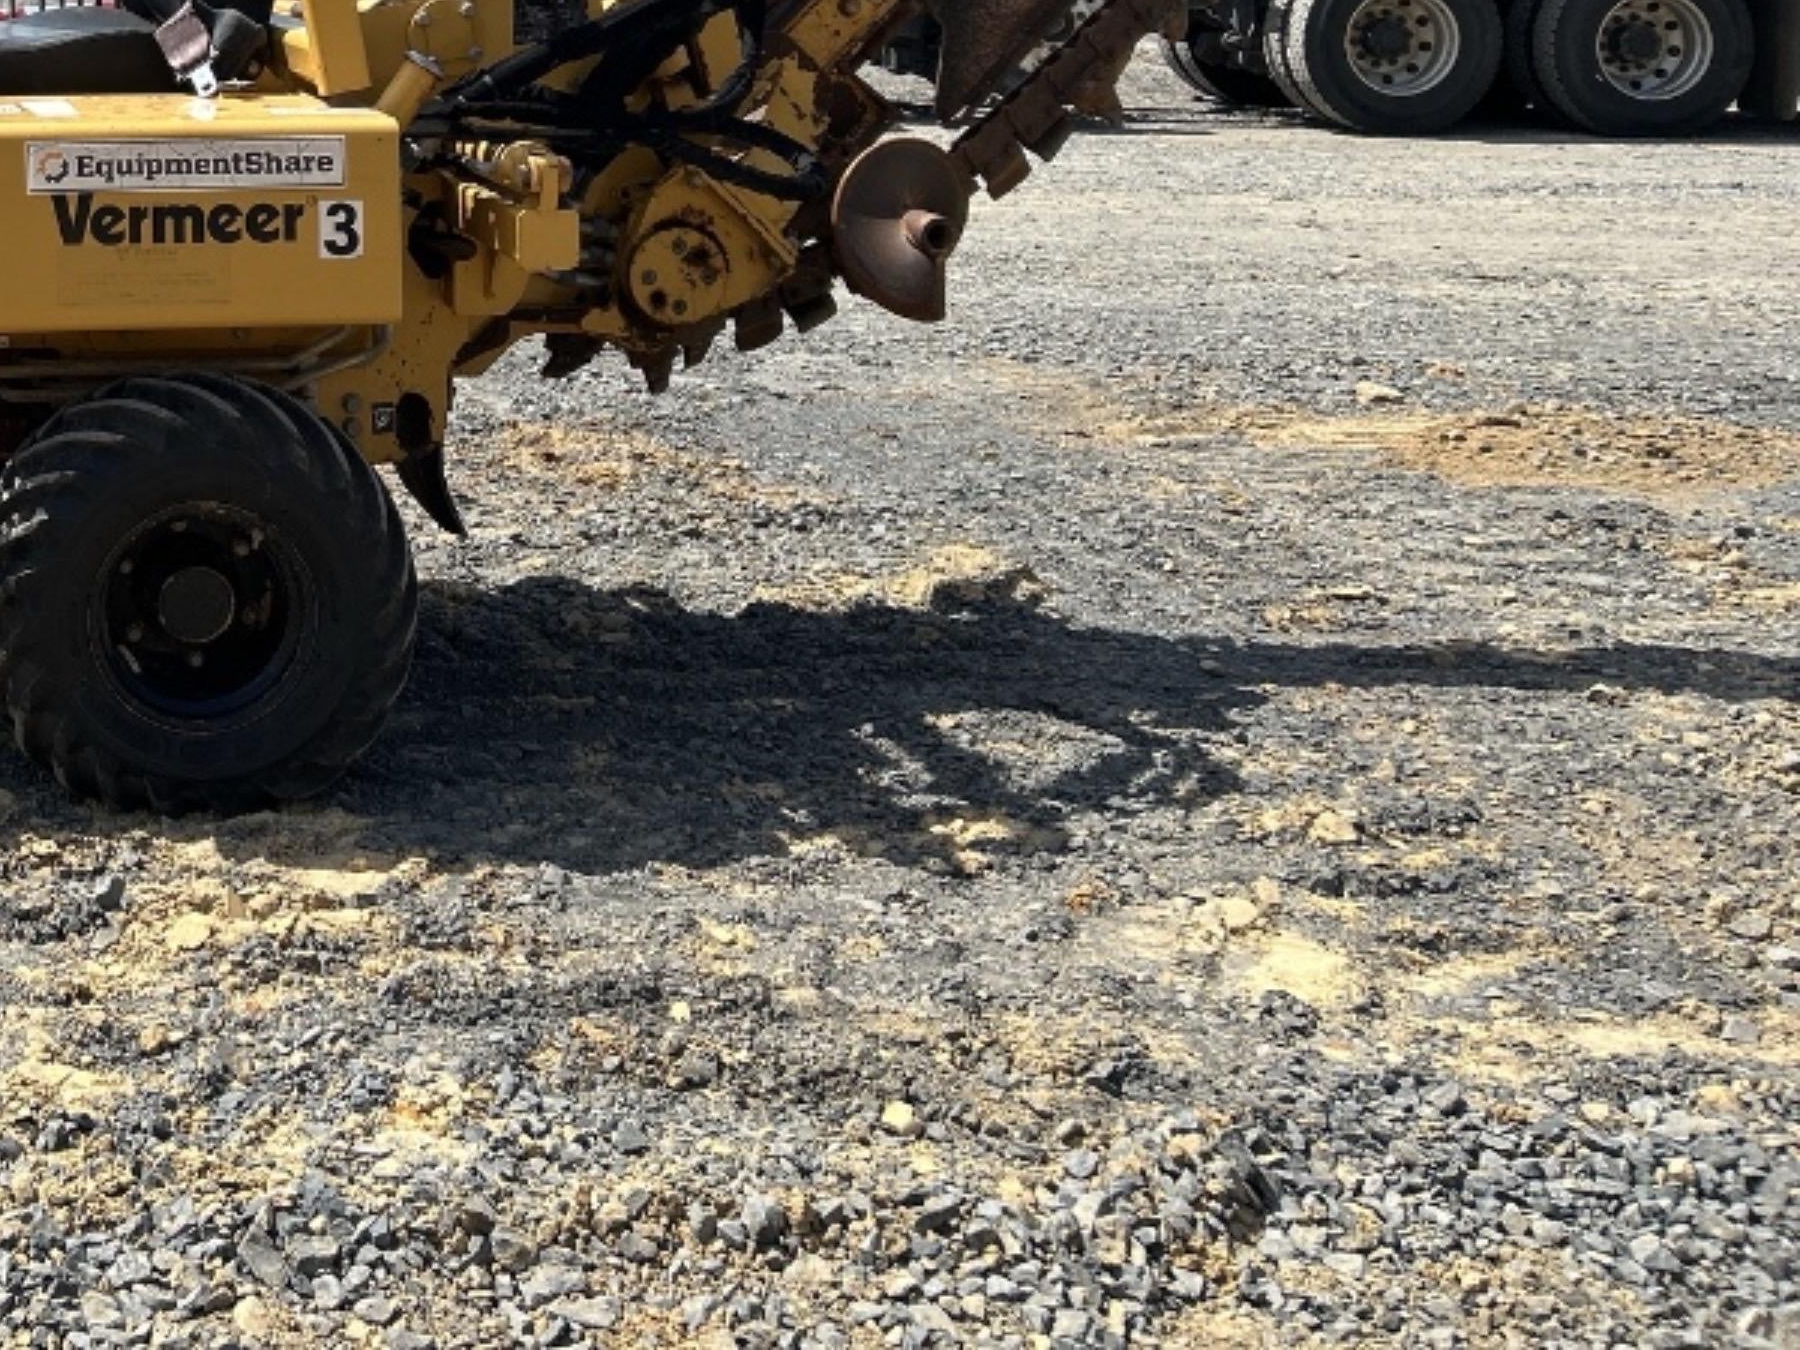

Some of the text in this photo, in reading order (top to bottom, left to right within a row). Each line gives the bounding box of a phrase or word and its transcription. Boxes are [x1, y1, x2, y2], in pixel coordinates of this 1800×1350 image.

[75, 152, 334, 183] EquipmentShare
[51, 193, 304, 245] Vermeer
[323, 203, 360, 256] 3
